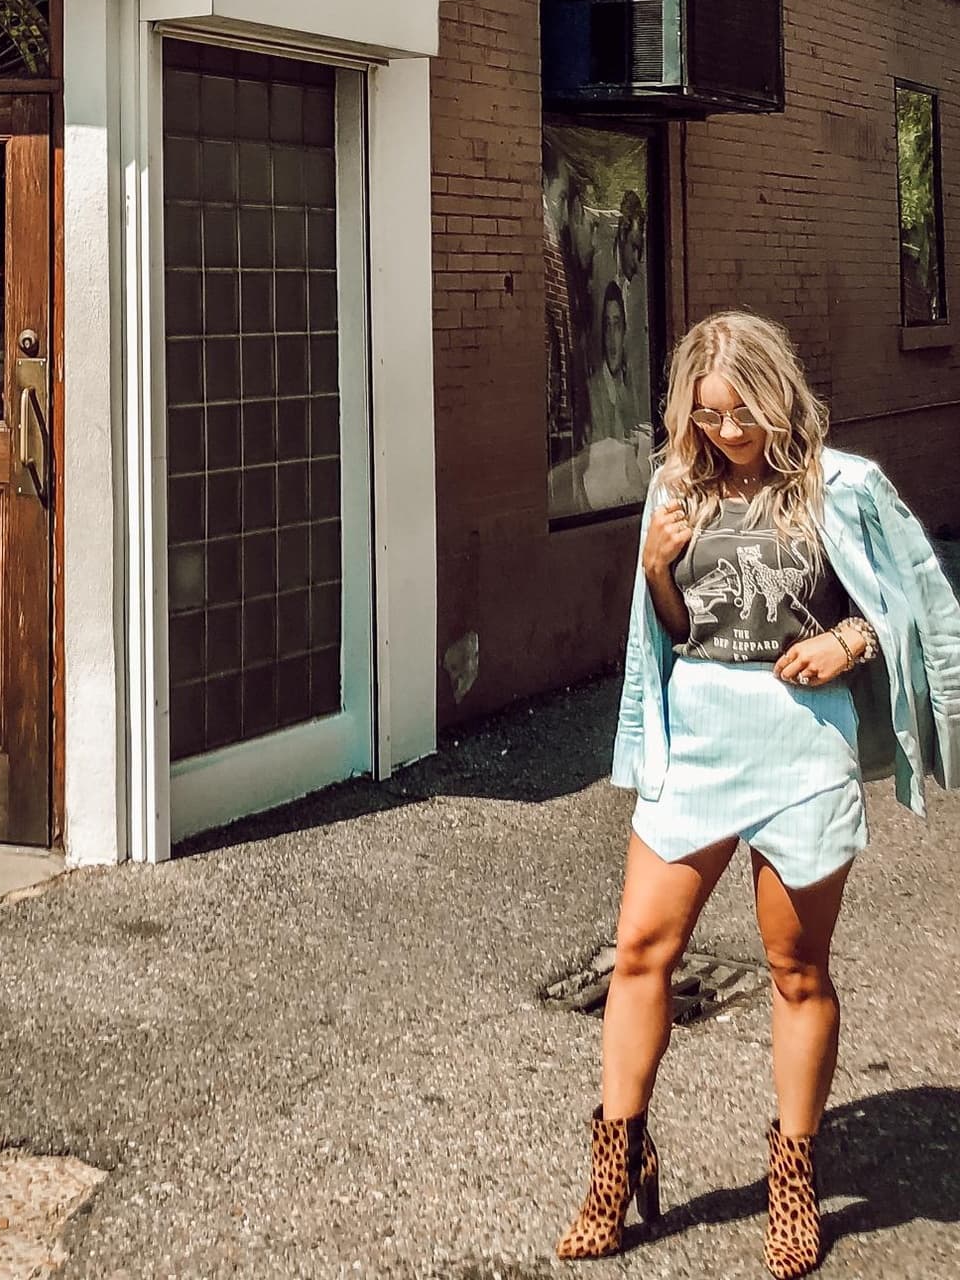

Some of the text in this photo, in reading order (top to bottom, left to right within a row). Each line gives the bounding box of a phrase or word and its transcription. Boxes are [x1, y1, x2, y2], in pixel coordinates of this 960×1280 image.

[733, 628, 750, 639] THE
[713, 637, 780, 652] DEF LEPPARD
